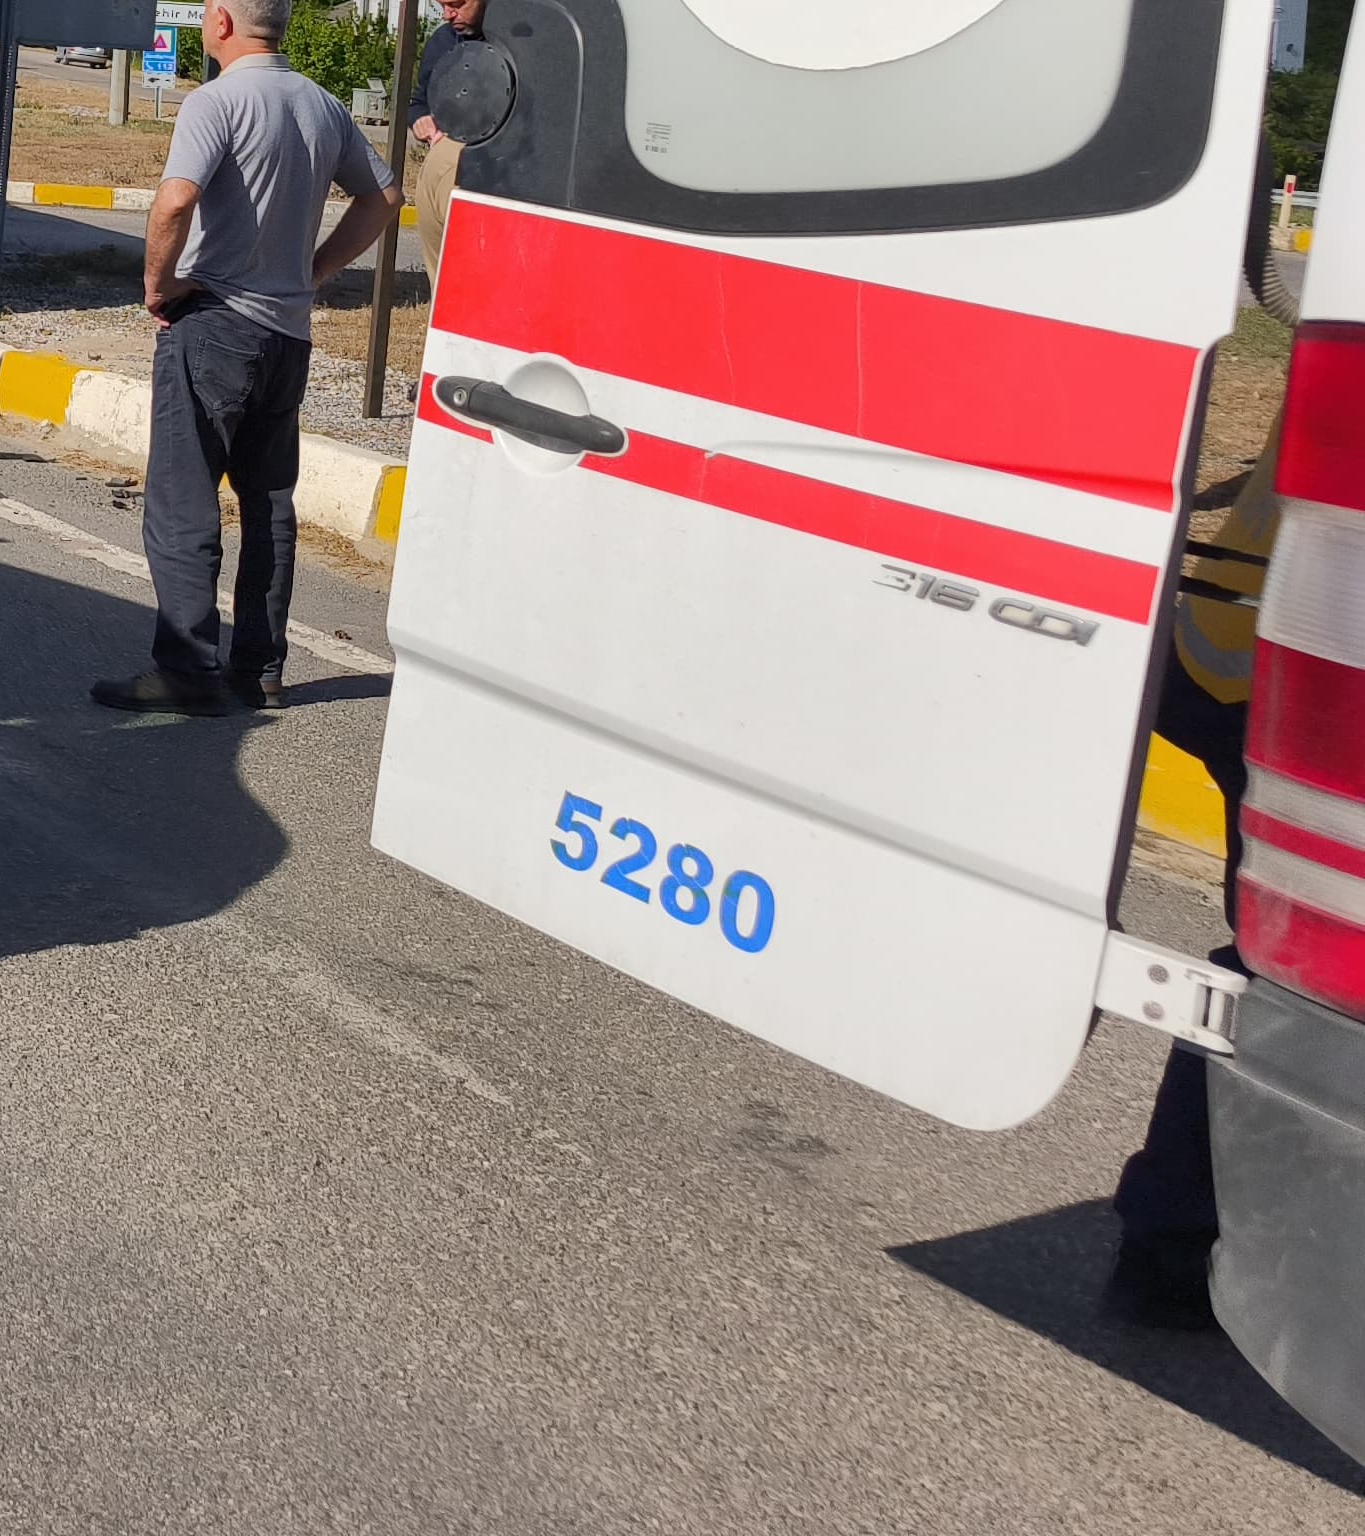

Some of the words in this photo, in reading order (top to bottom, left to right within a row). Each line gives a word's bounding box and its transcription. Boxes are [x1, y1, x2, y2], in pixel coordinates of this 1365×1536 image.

[872, 563, 981, 612] 316
[988, 596, 1101, 647] CDI
[549, 789, 777, 954] 5280
